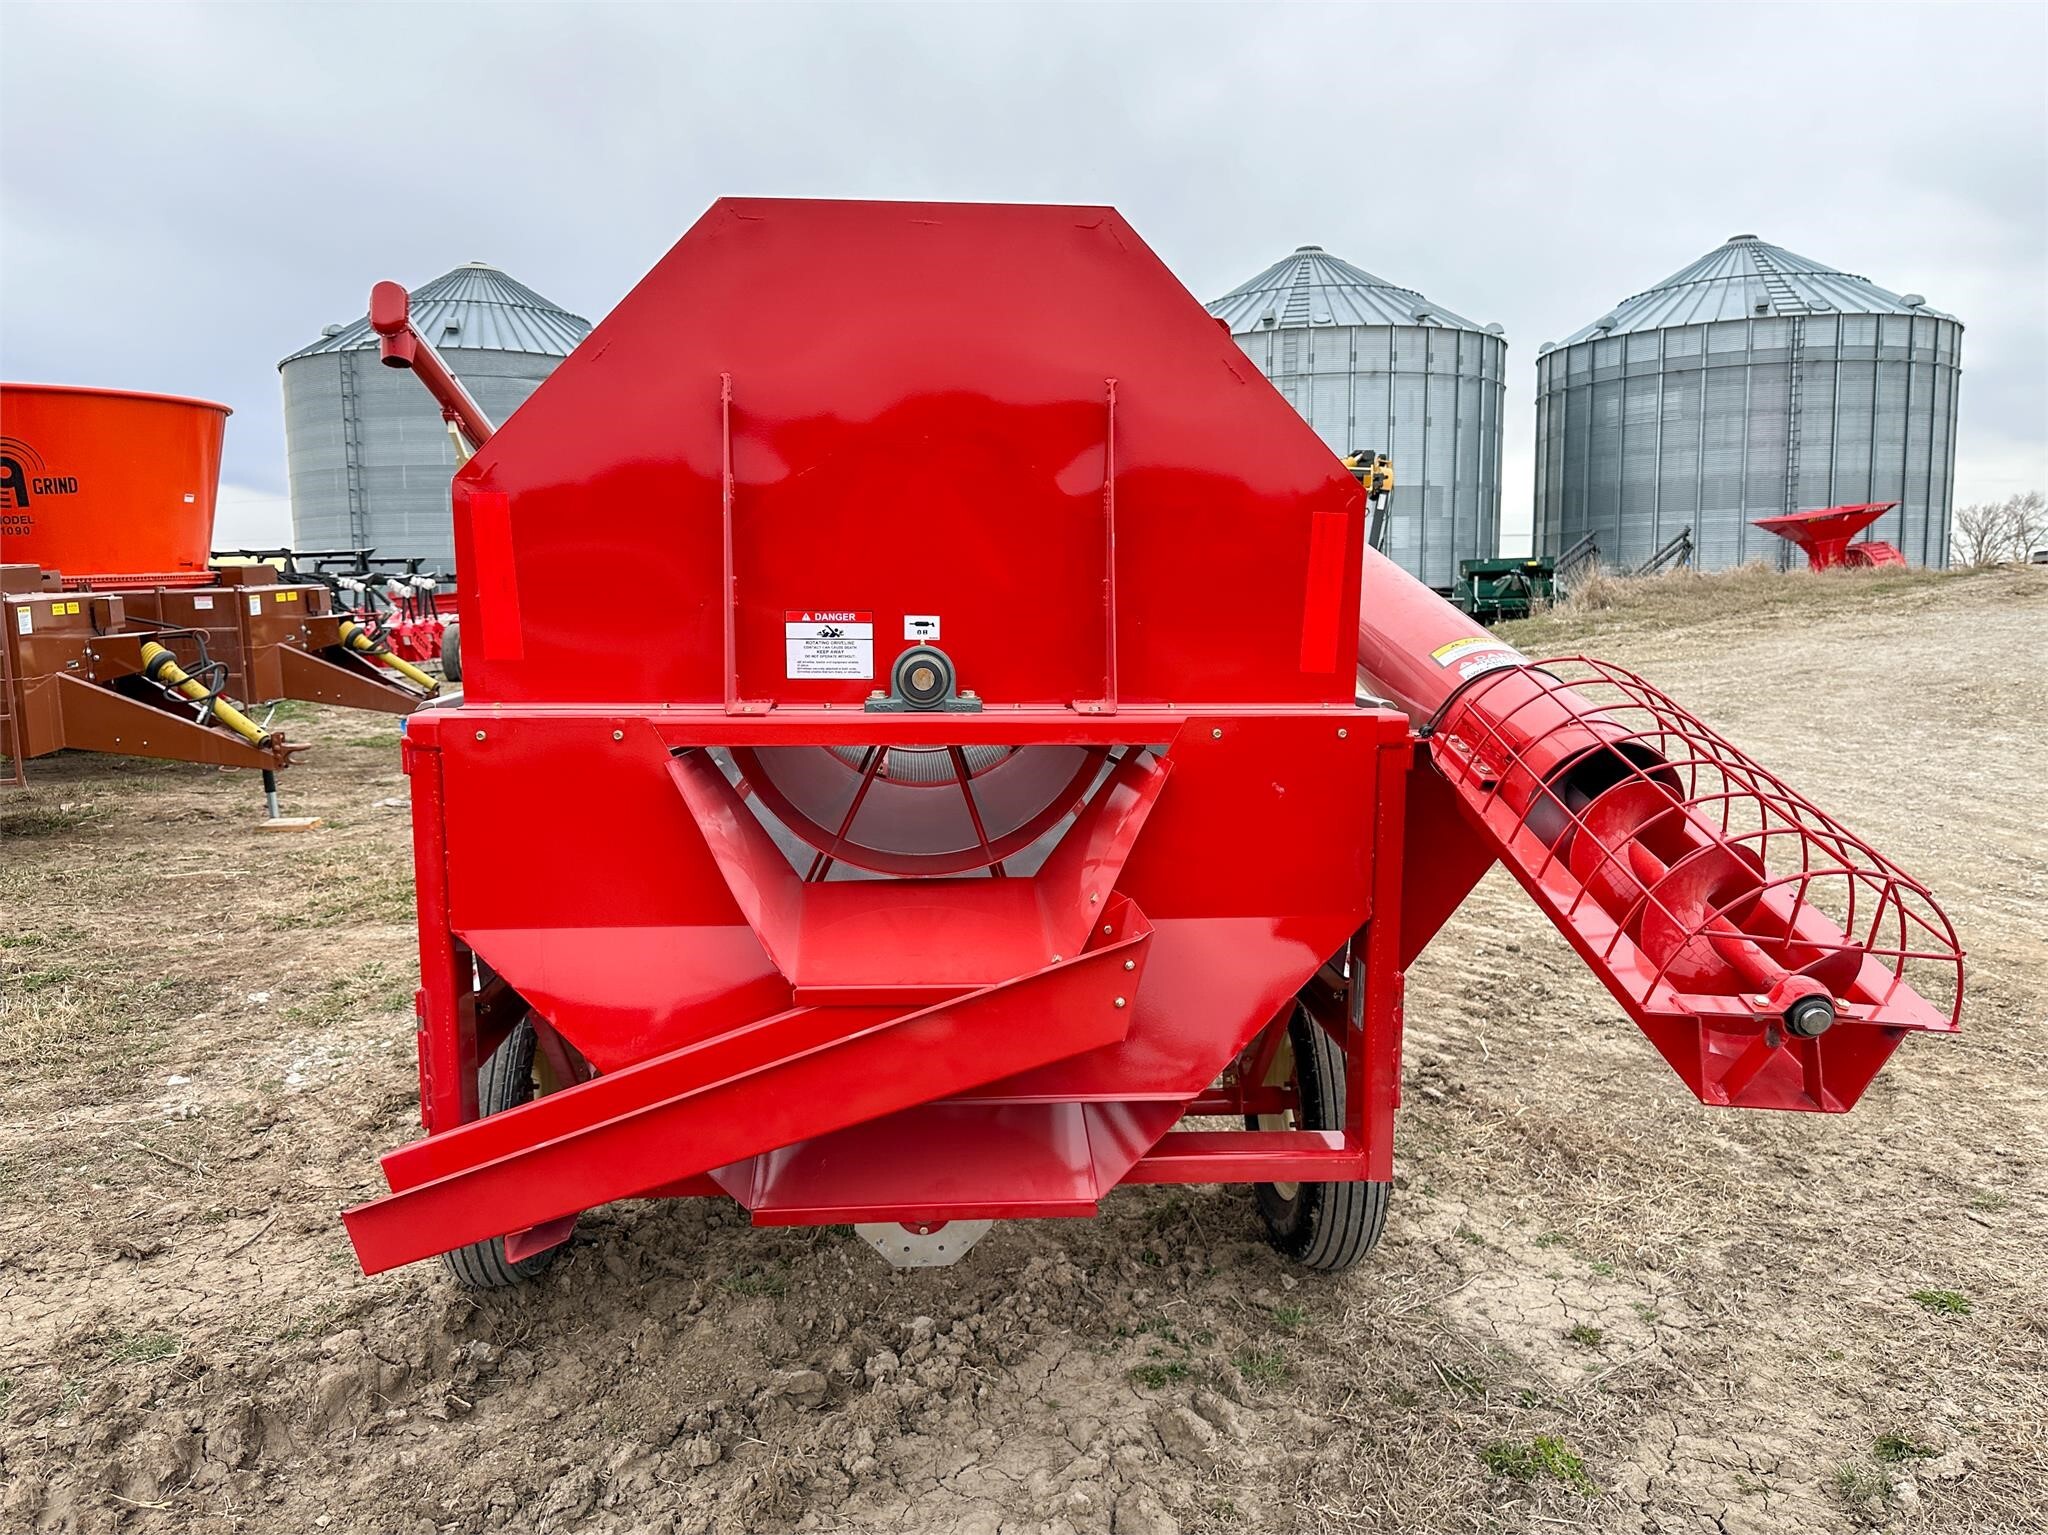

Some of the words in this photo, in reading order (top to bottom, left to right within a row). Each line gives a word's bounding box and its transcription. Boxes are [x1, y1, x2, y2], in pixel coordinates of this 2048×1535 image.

[32, 477, 78, 495] GRIND
[0, 515, 35, 525] ODEL
[0, 526, 30, 536] 1090
[814, 613, 856, 621] DANGER
